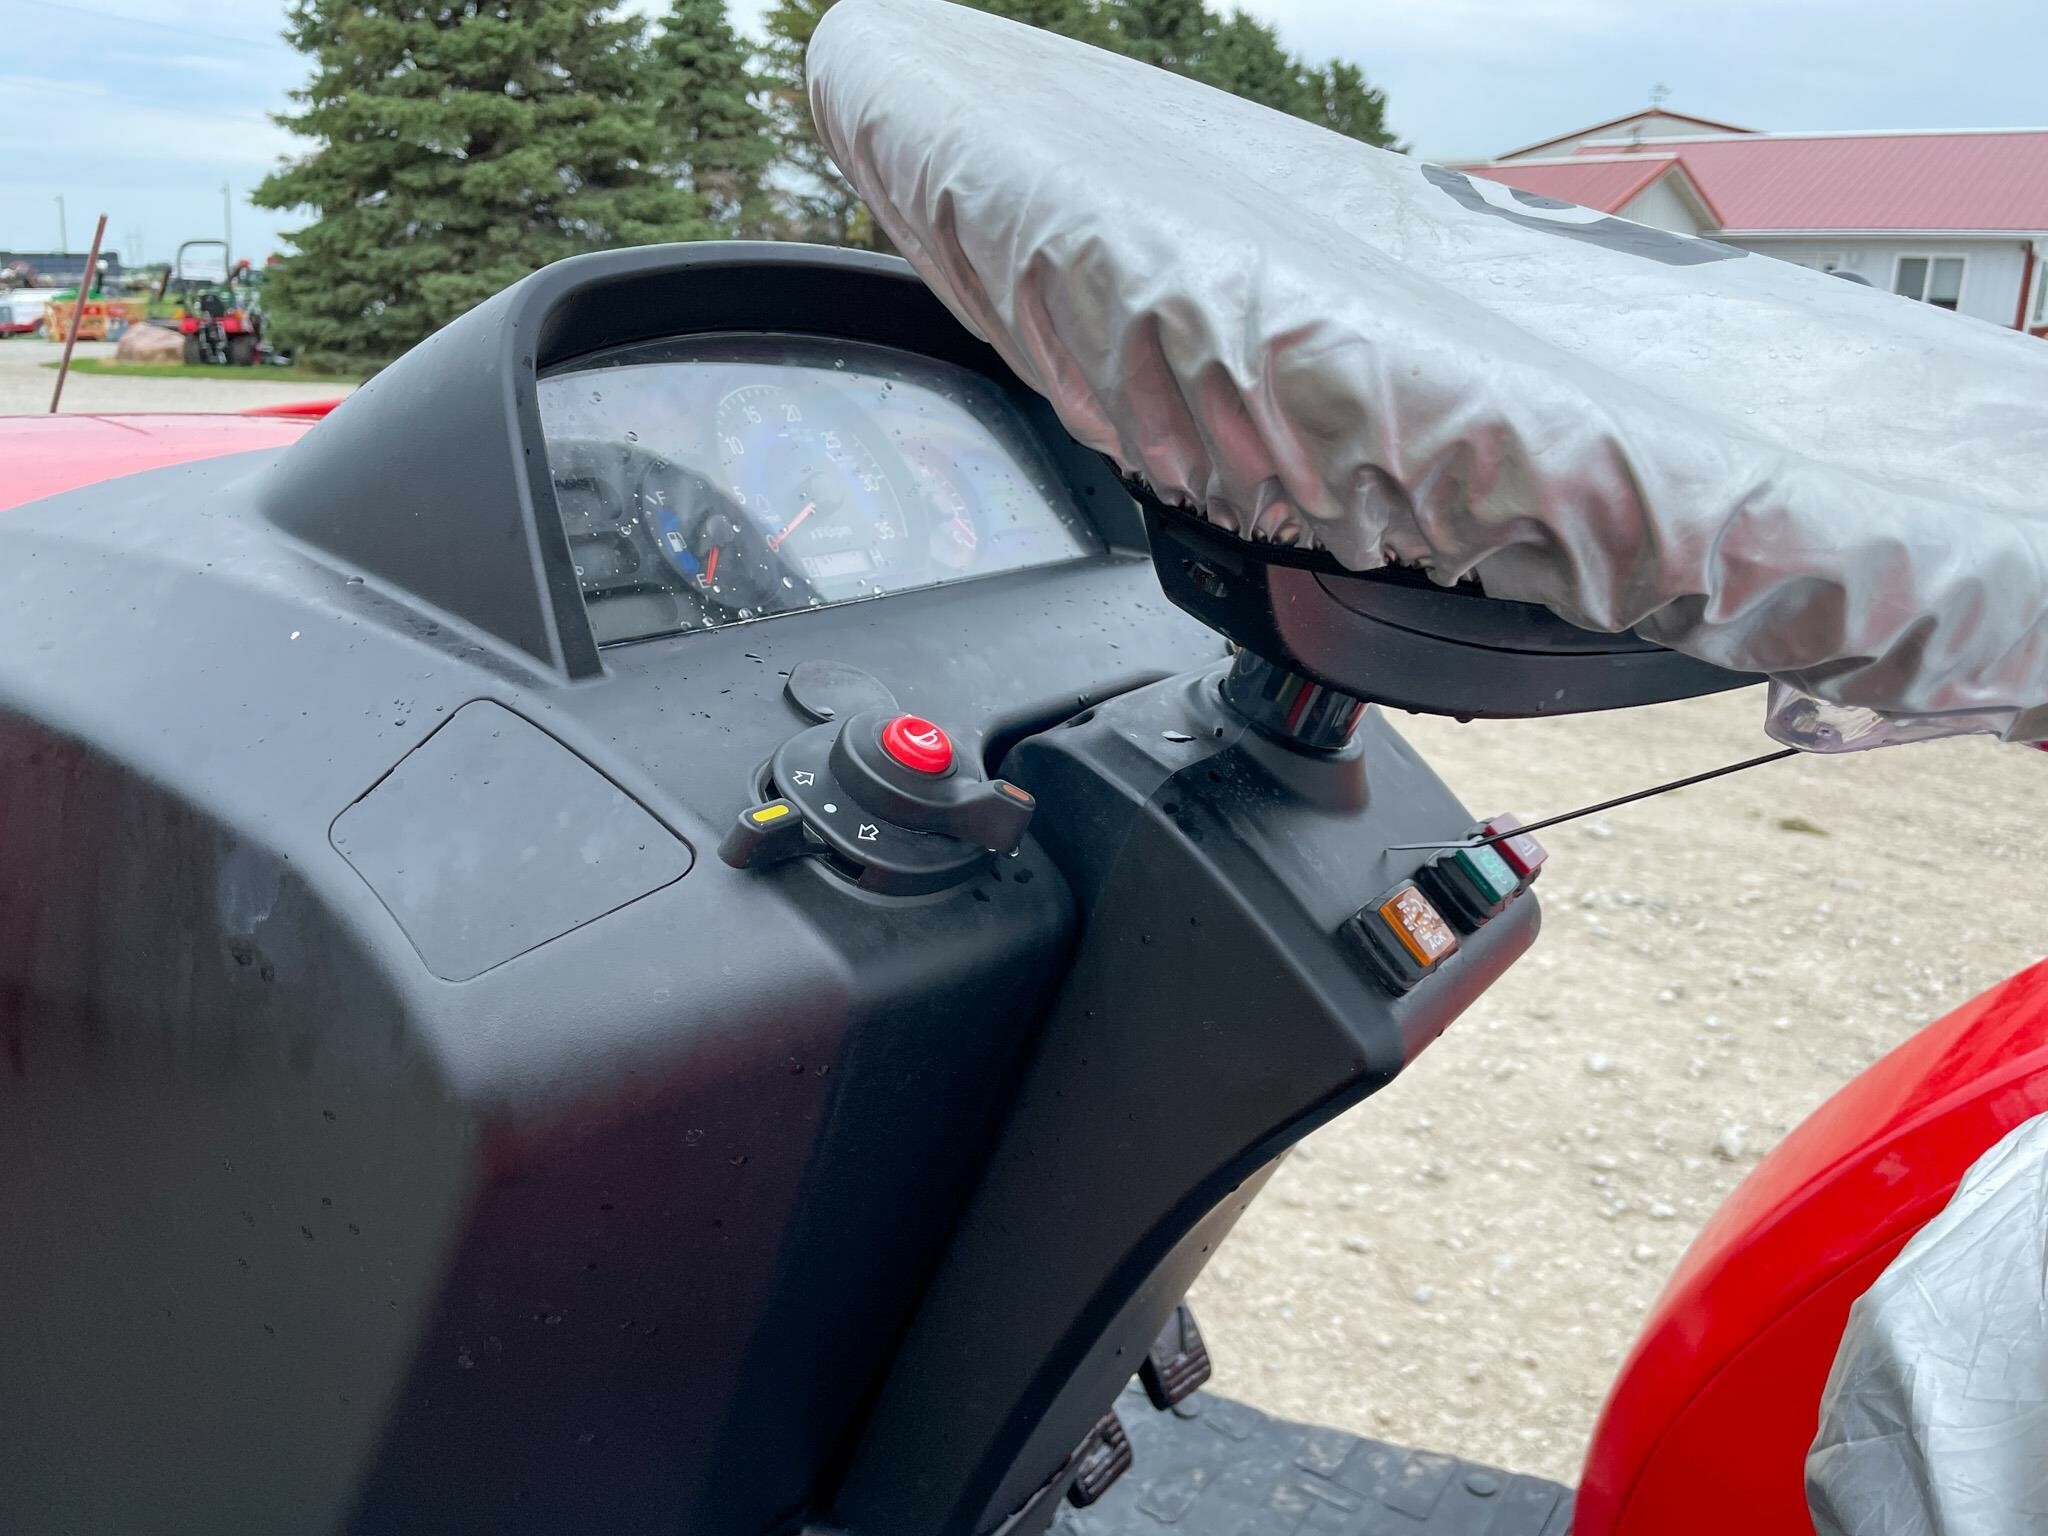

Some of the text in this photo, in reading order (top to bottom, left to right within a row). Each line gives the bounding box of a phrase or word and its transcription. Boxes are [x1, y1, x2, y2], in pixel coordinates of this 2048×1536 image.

[741, 404, 763, 425] 15
[780, 402, 804, 423] 20
[723, 434, 745, 456] 10
[732, 484, 747, 505] 5
[873, 520, 896, 541] 35
[694, 572, 712, 590] E
